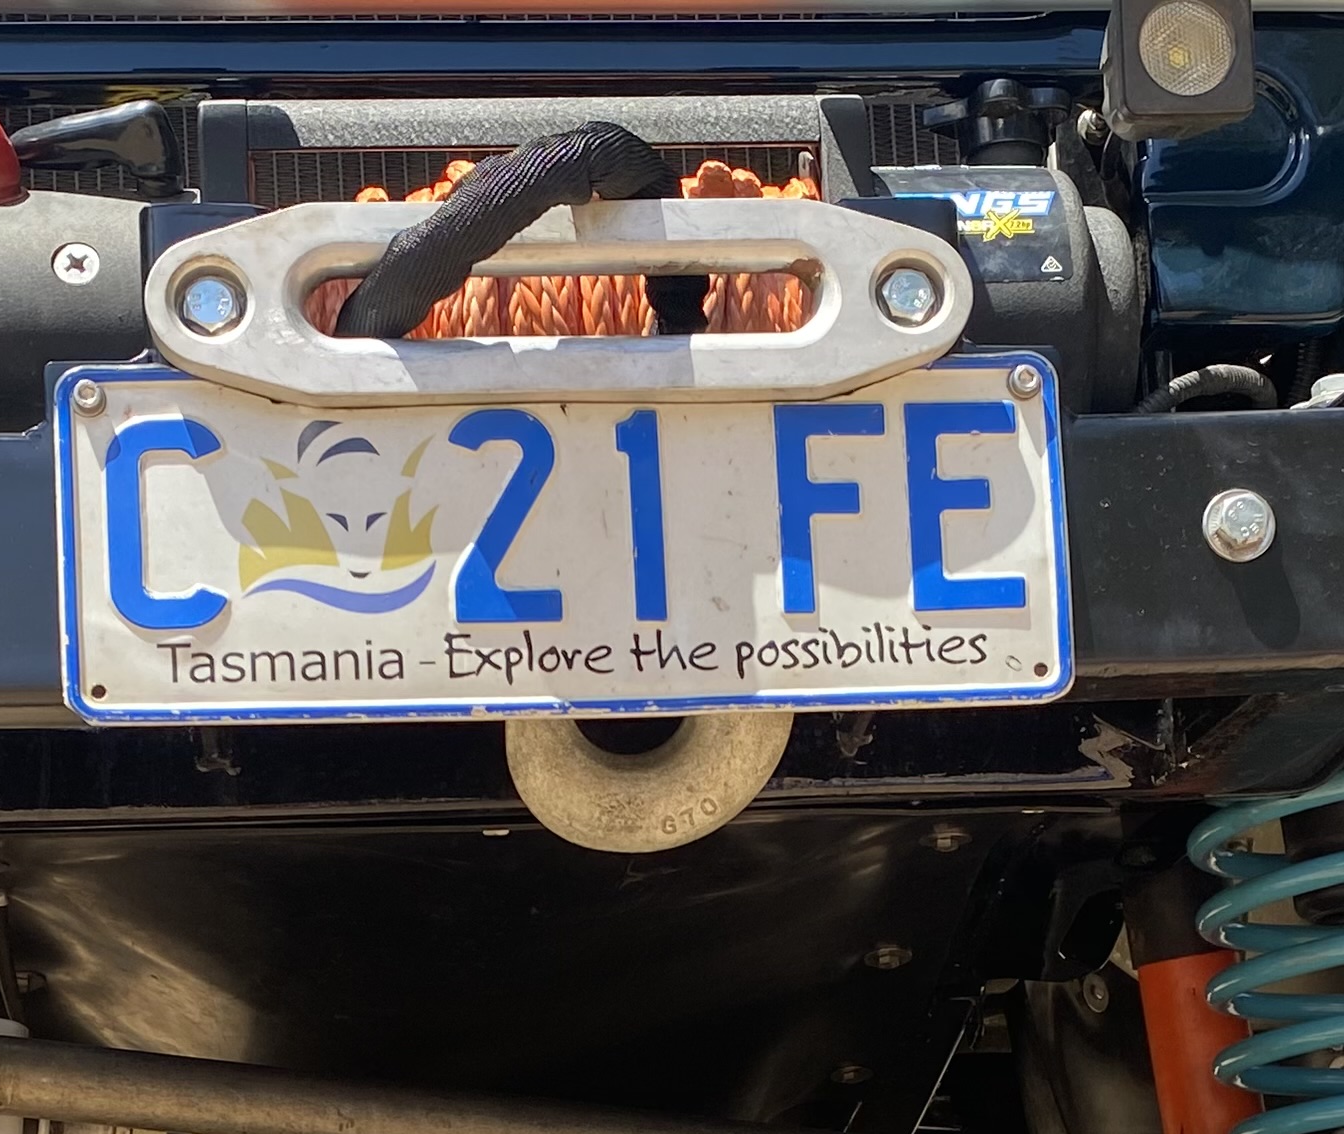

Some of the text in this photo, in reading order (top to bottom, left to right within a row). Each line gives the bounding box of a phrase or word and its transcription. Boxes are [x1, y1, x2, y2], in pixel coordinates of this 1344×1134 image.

[104, 401, 1027, 631] C 21 FE
[156, 639, 405, 684] Tasmania
[443, 629, 615, 686] Explore
[629, 628, 719, 673] the
[735, 621, 988, 680] possibilities
